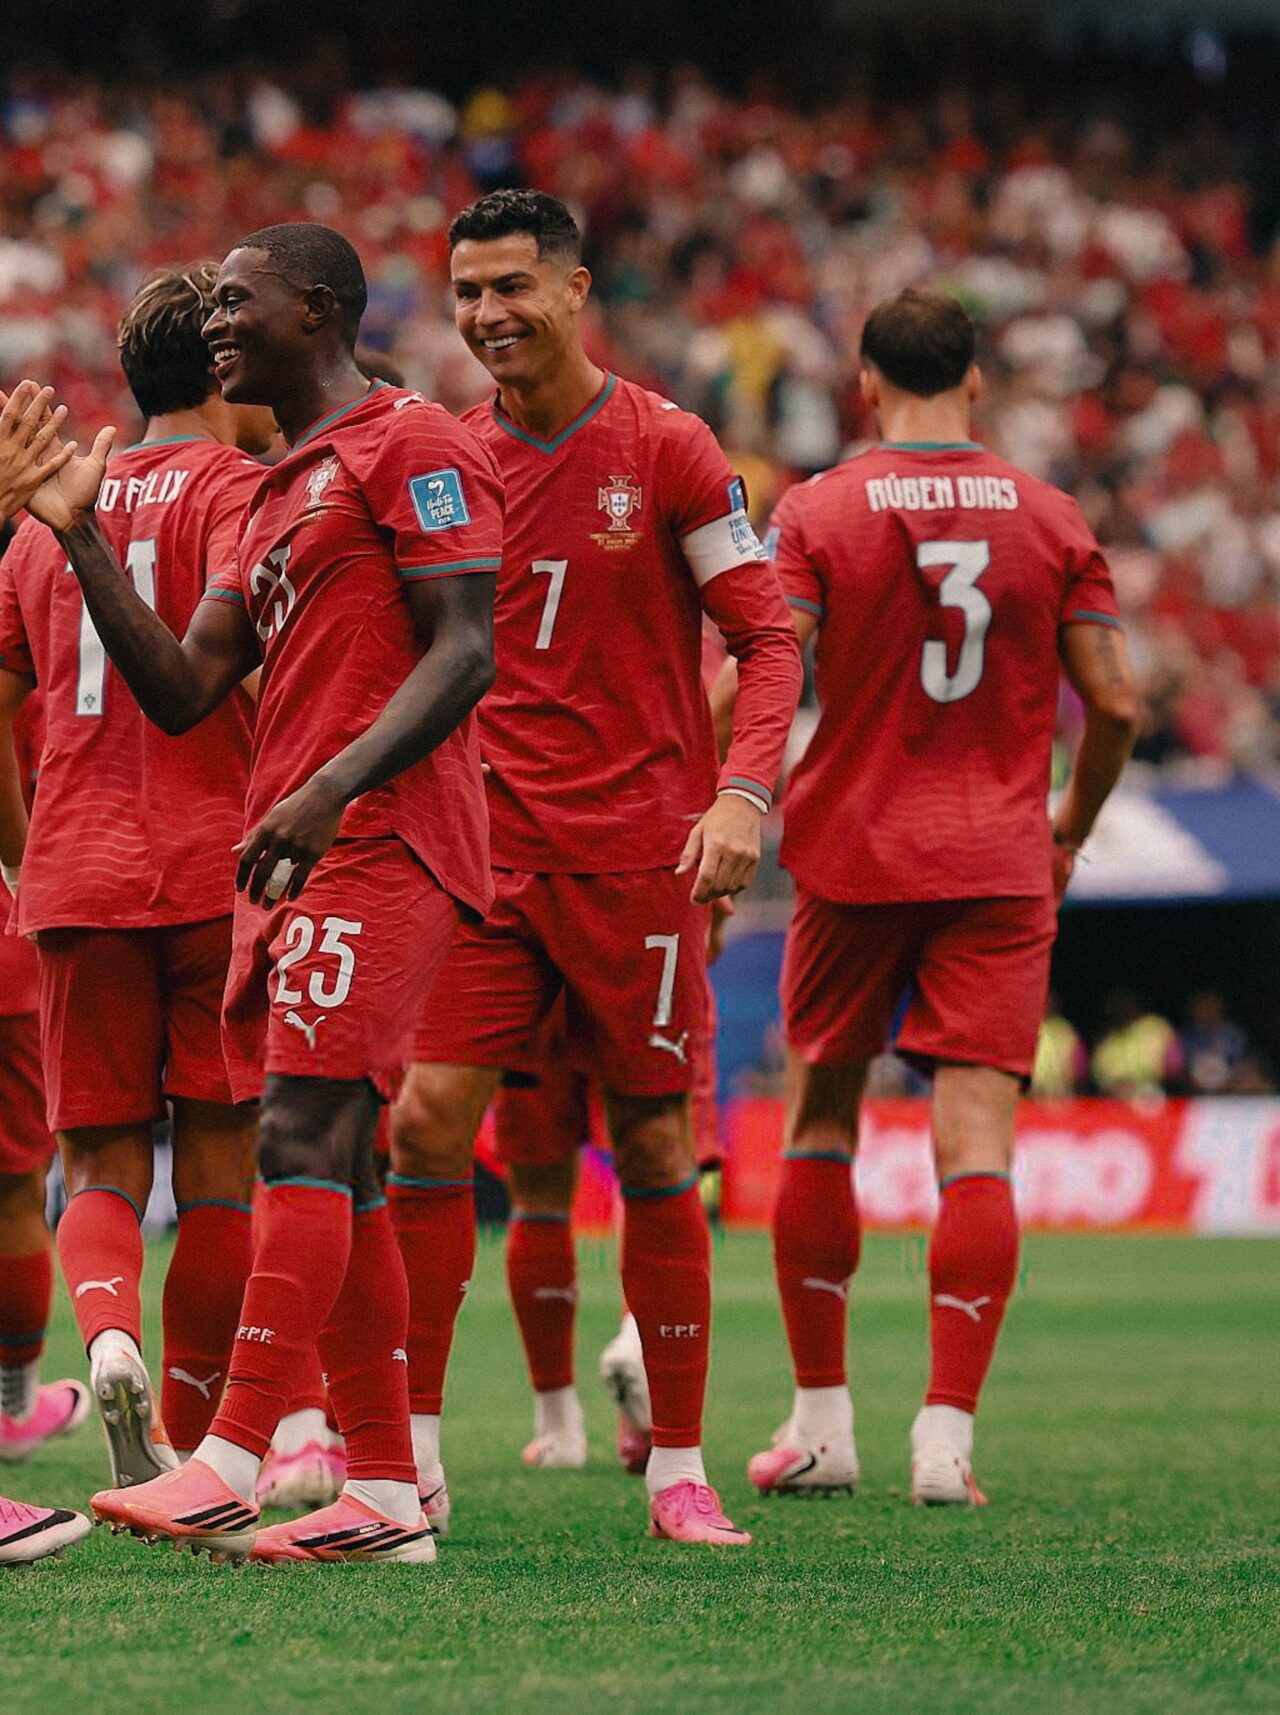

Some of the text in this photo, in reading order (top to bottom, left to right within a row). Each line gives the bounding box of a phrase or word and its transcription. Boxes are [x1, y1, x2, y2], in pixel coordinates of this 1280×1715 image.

[865, 472, 1019, 512] RÚBEN DIAS
[531, 560, 569, 651] 7
[916, 540, 993, 704] 3
[273, 915, 363, 1009] 25
[643, 932, 680, 1027] 7
